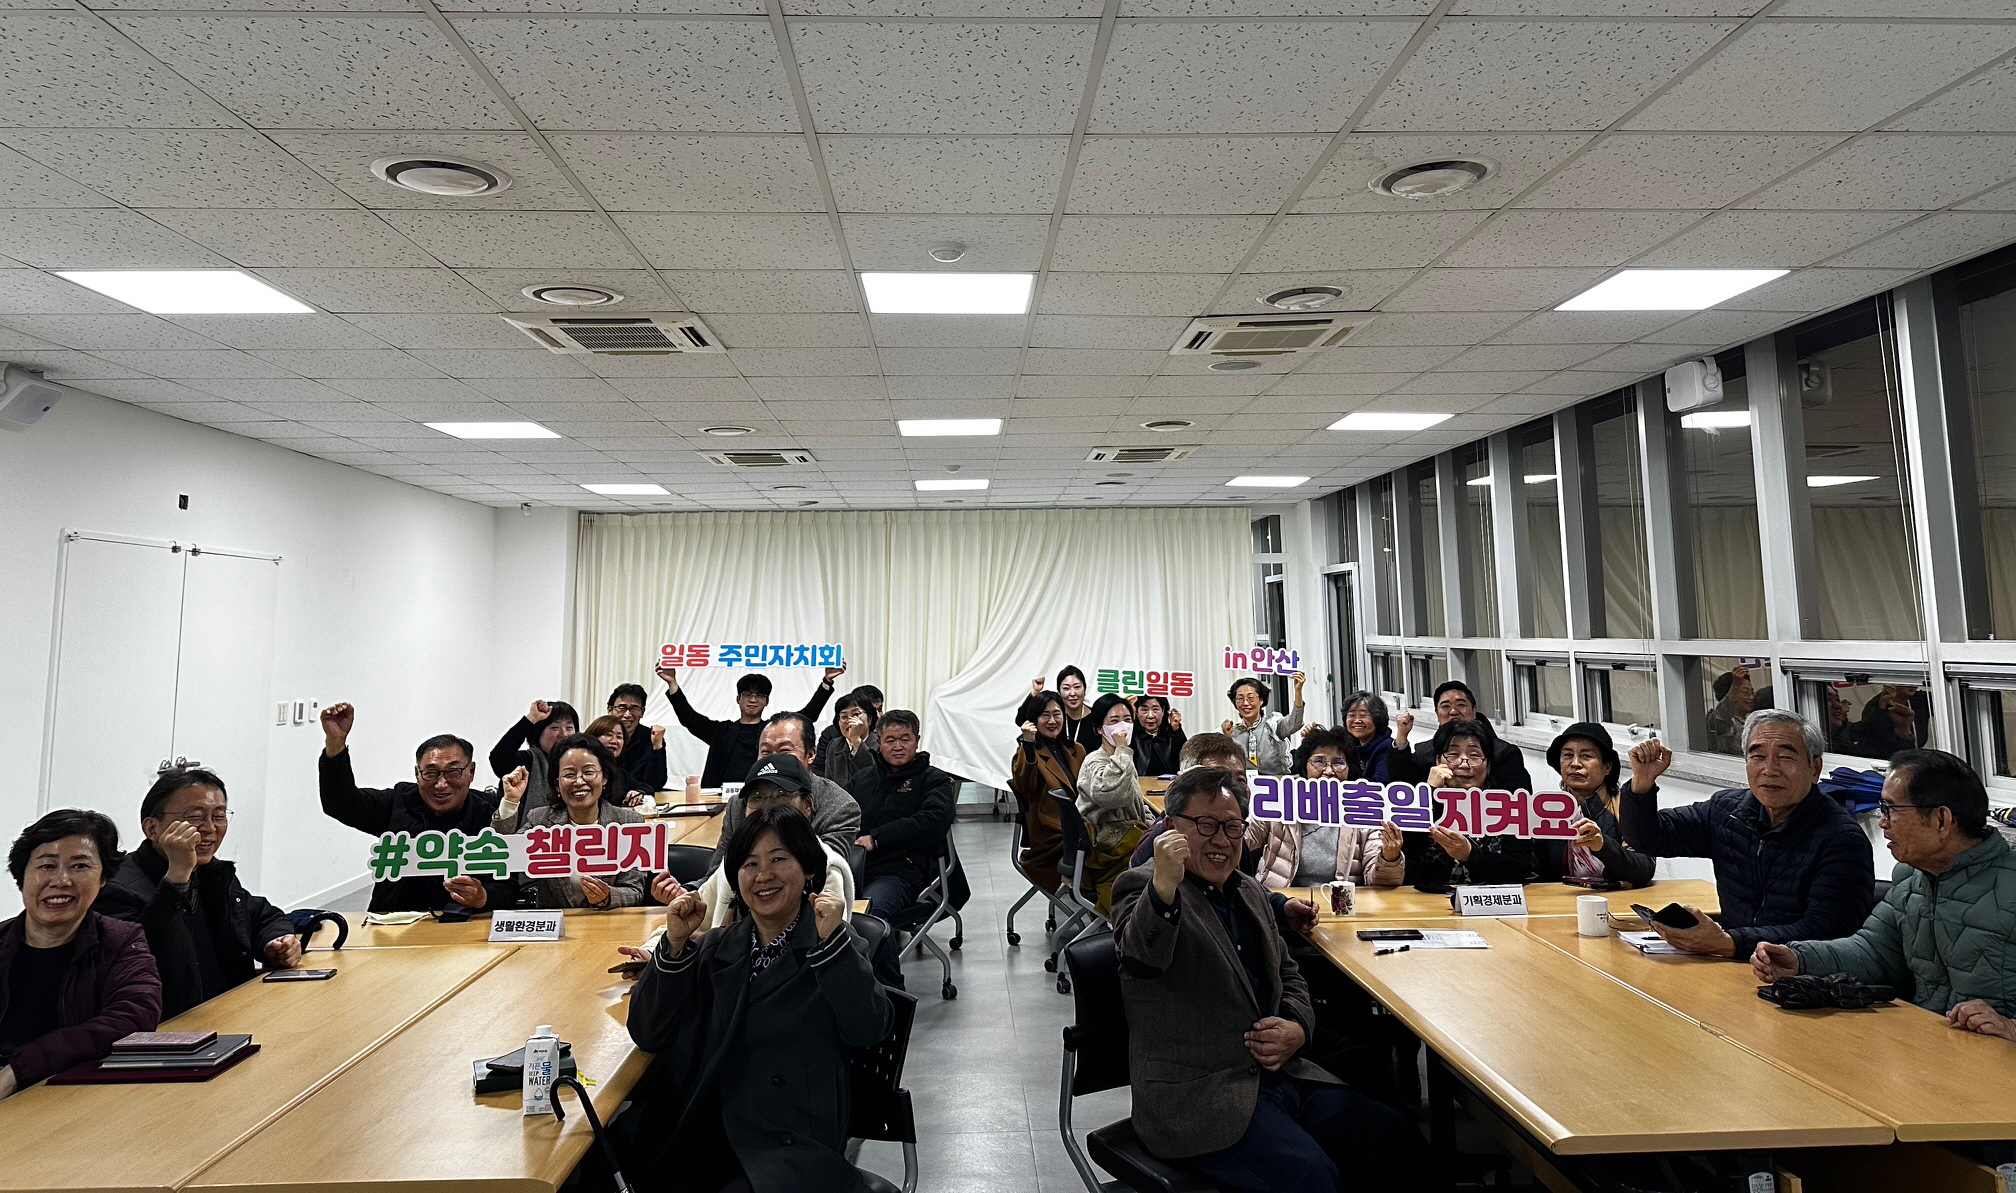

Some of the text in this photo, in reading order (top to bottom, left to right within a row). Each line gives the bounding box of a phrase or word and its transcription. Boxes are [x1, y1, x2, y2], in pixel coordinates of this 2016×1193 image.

[661, 644, 841, 667] 일동 주민자치회
[1253, 778, 1432, 829] 리배출일
[370, 823, 665, 879] #약속 챌린지
[1463, 894, 1522, 906] 기획경제분과
[494, 920, 557, 933] 생활환경분과
[528, 1076, 551, 1087] WATER
